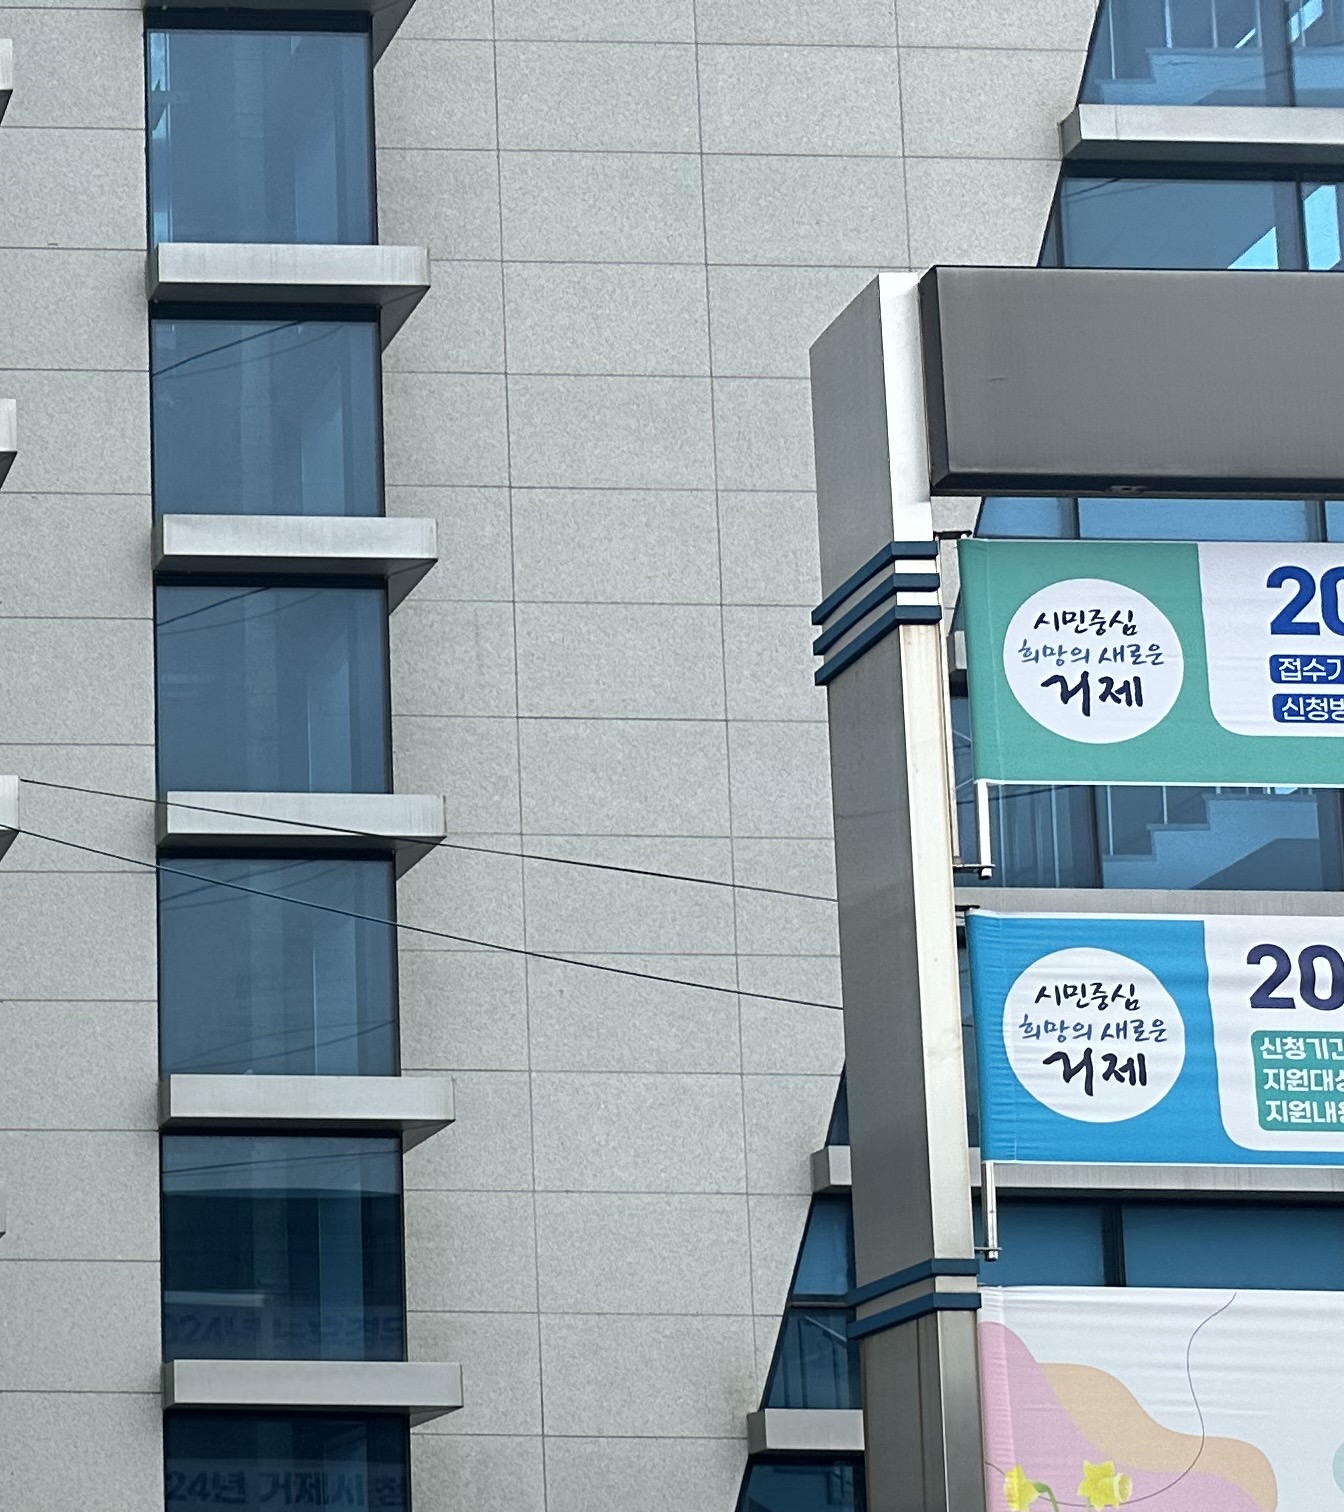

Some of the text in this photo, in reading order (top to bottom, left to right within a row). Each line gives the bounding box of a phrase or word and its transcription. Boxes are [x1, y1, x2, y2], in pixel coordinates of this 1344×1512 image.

[1033, 608, 1138, 637] 시민중심
[1018, 638, 1165, 667] 희망의 새로운
[1041, 670, 1144, 718] 거제
[1035, 982, 1141, 1012] 시민중심
[1019, 1014, 1168, 1044] 희망의 새로운
[1043, 1048, 1147, 1097] 거제
